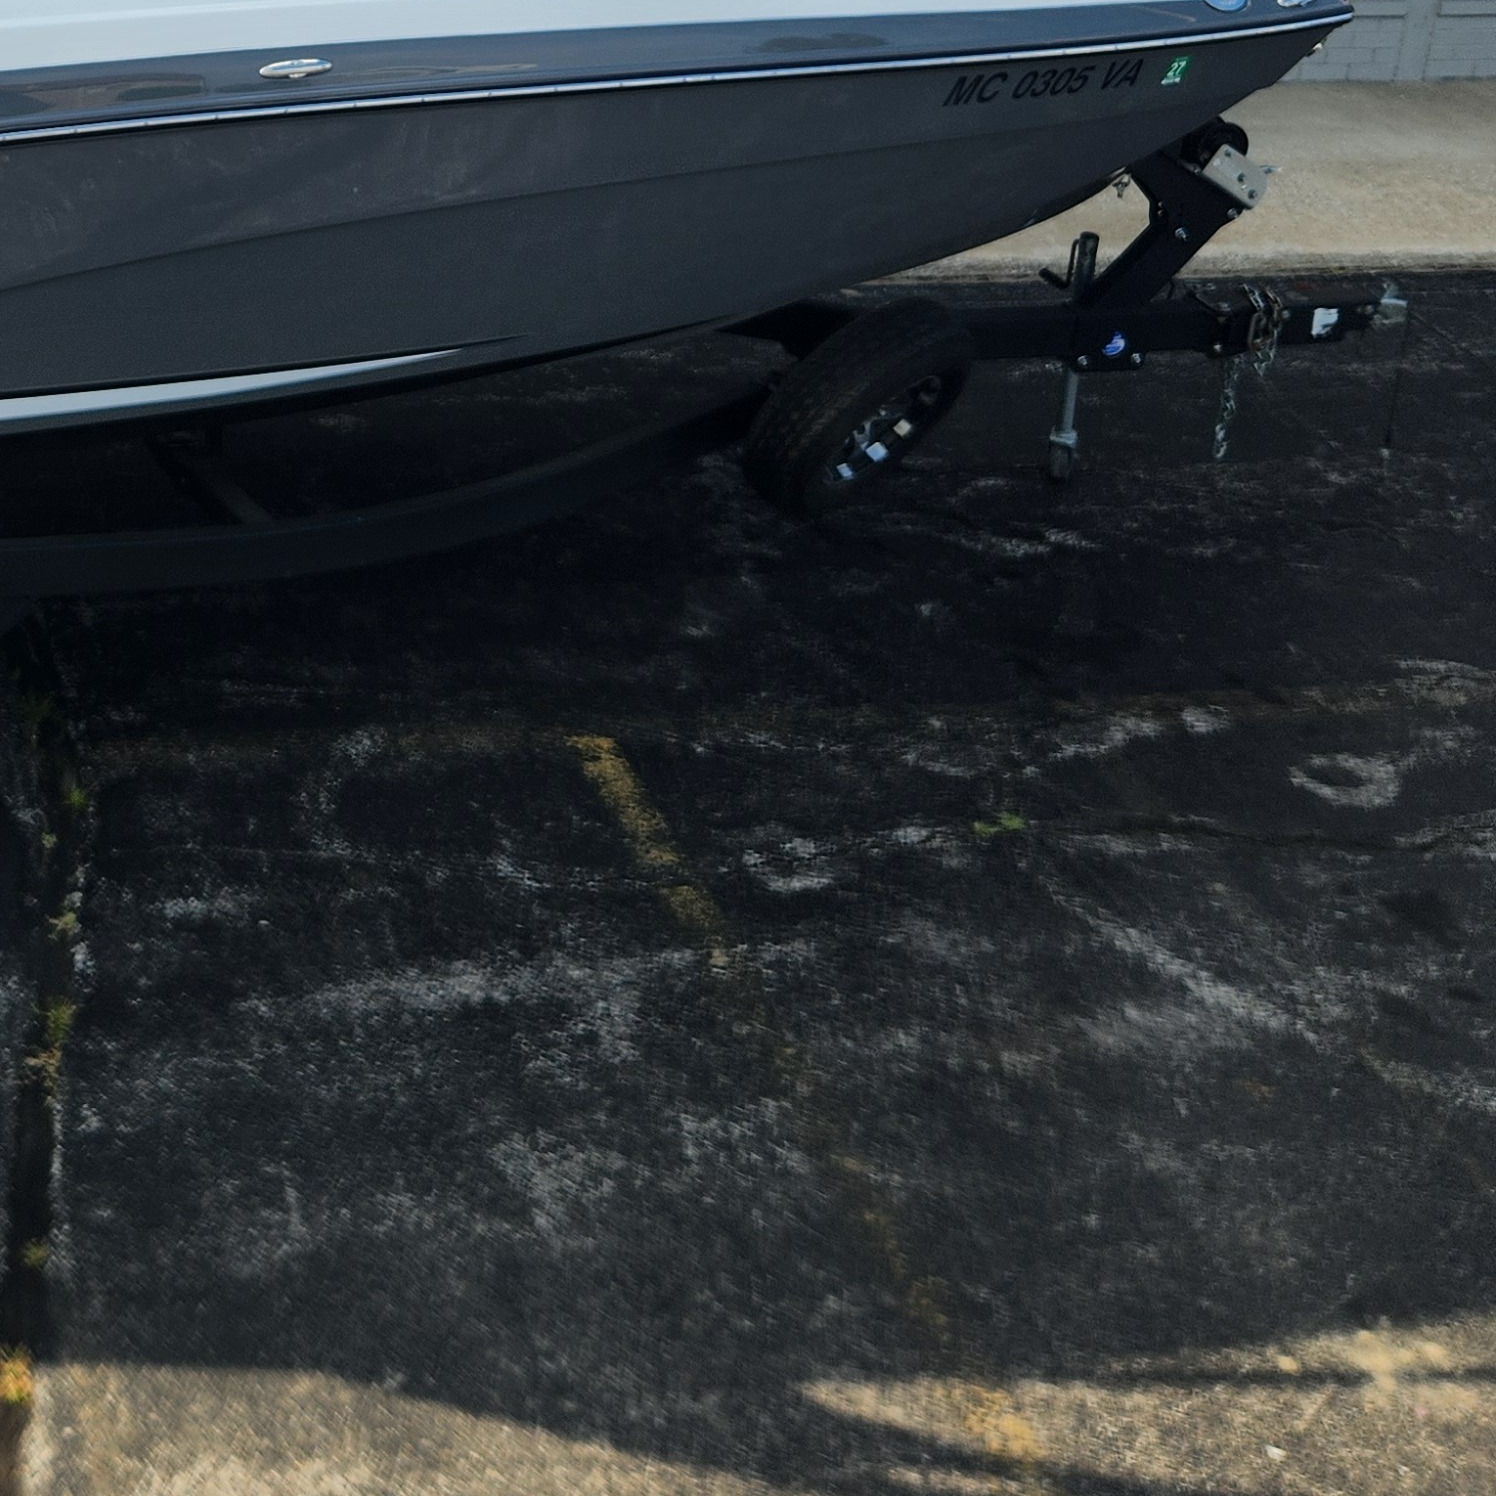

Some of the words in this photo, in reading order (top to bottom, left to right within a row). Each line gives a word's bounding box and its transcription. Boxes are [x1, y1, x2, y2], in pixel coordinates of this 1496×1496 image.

[943, 71, 1007, 106] MC
[1011, 65, 1096, 99] 0305
[1101, 58, 1144, 89] VA
